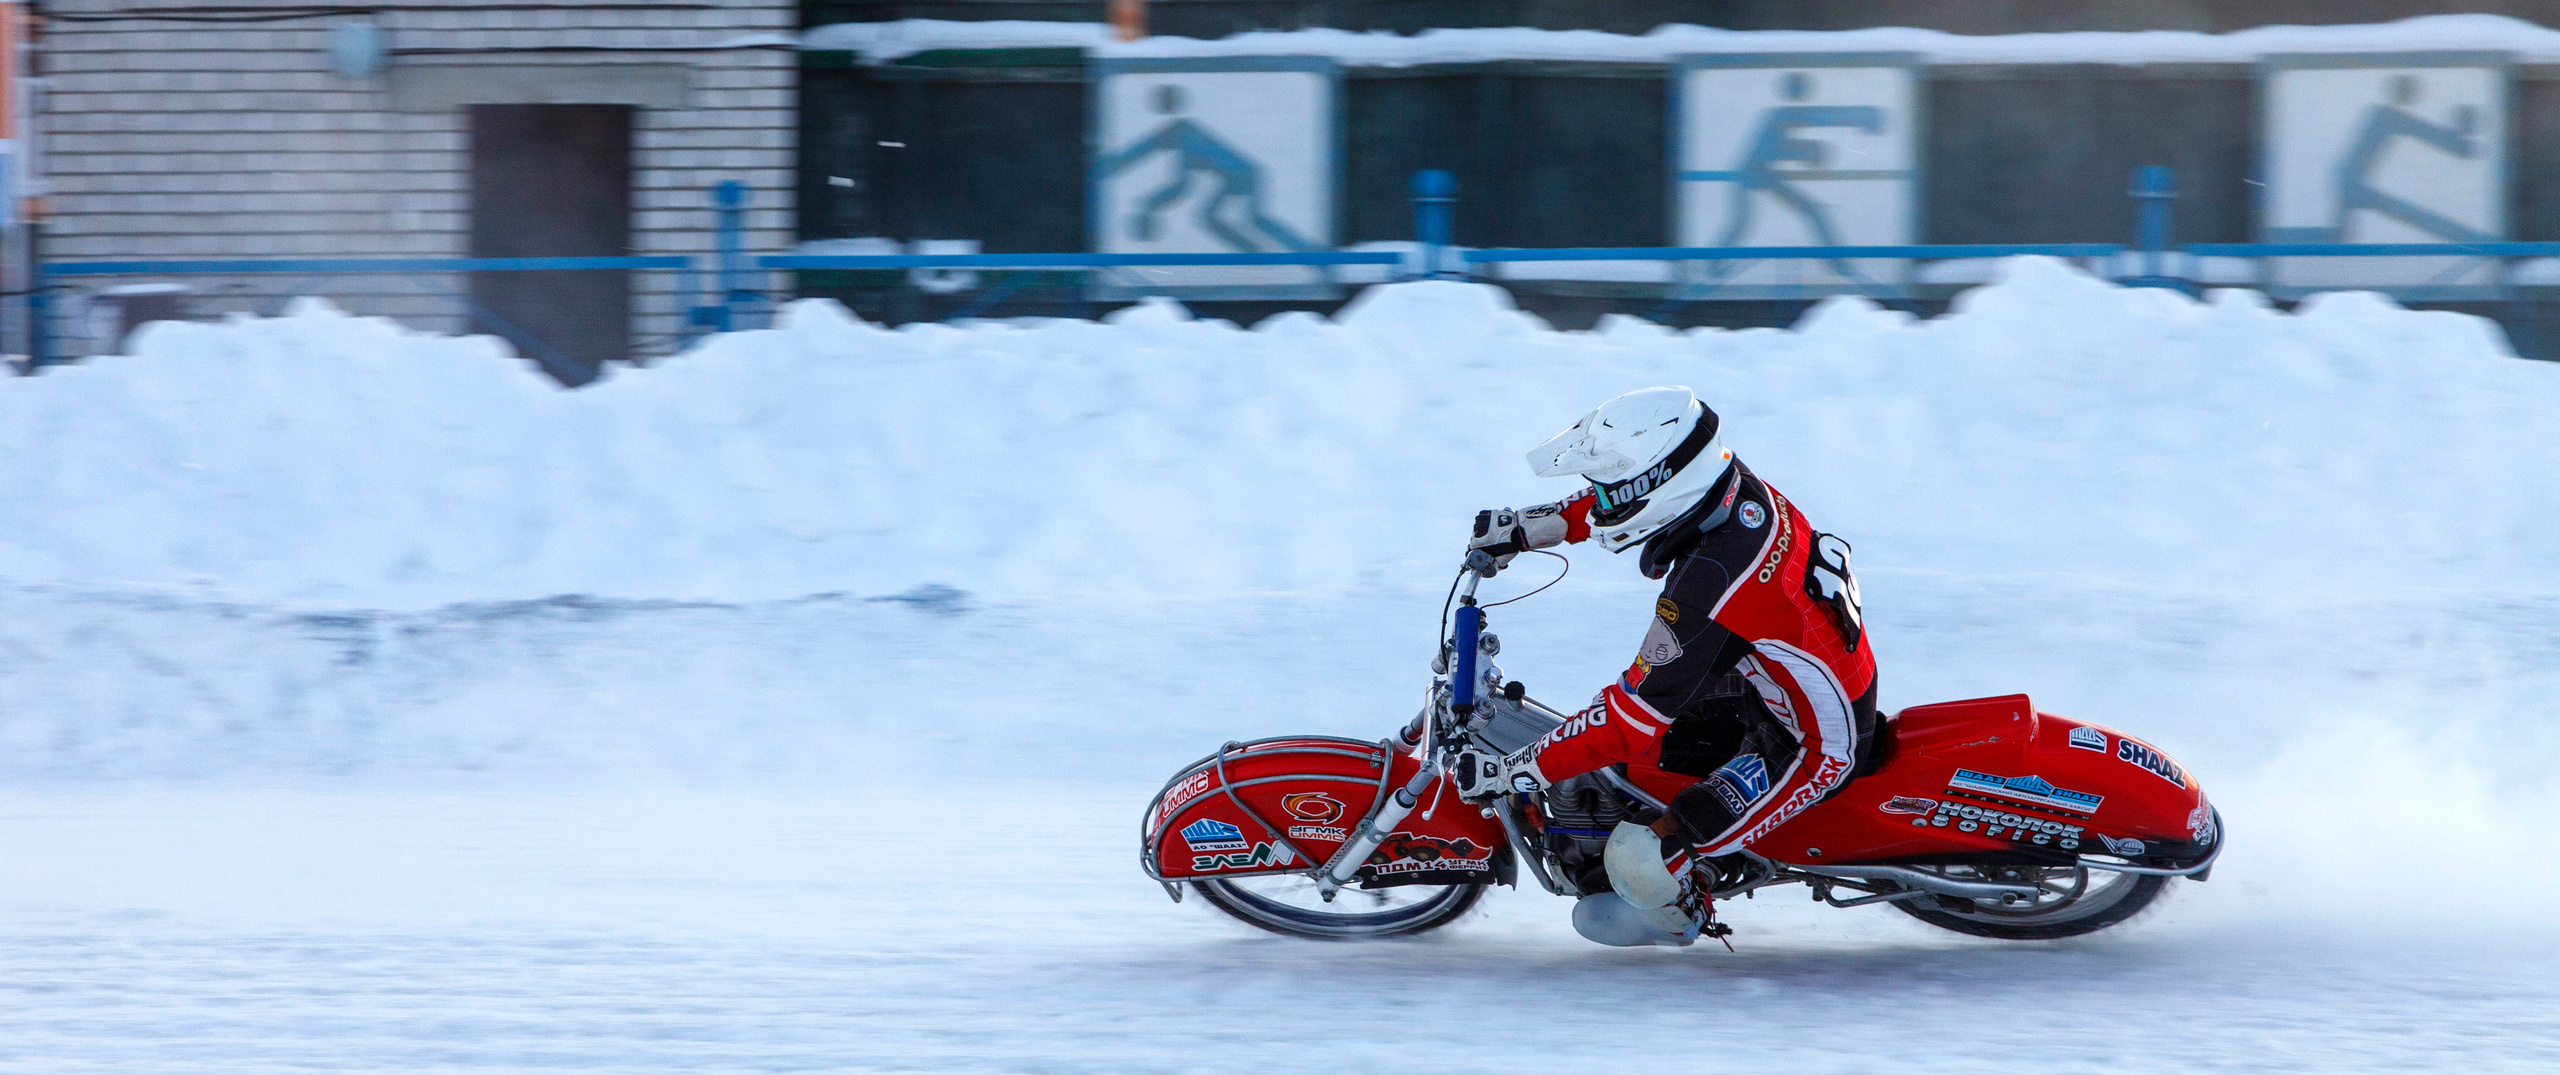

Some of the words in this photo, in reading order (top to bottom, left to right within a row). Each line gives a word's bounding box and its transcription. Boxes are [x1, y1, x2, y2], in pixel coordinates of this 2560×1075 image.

[1609, 460, 1673, 505] 100%
[2118, 739, 2186, 788] SHAAZ
[1958, 770, 2004, 784] ШААЗ
[1717, 784, 1745, 813] ШААЗ
[2055, 788, 2098, 803] SHAAZ
[1289, 826, 1344, 835] УГМК
[1937, 801, 2085, 839] НОКОЛОК
[1289, 832, 1345, 841] UMMC
[1931, 814, 2079, 849] SOFICO
[1448, 859, 1487, 867] УГМК
